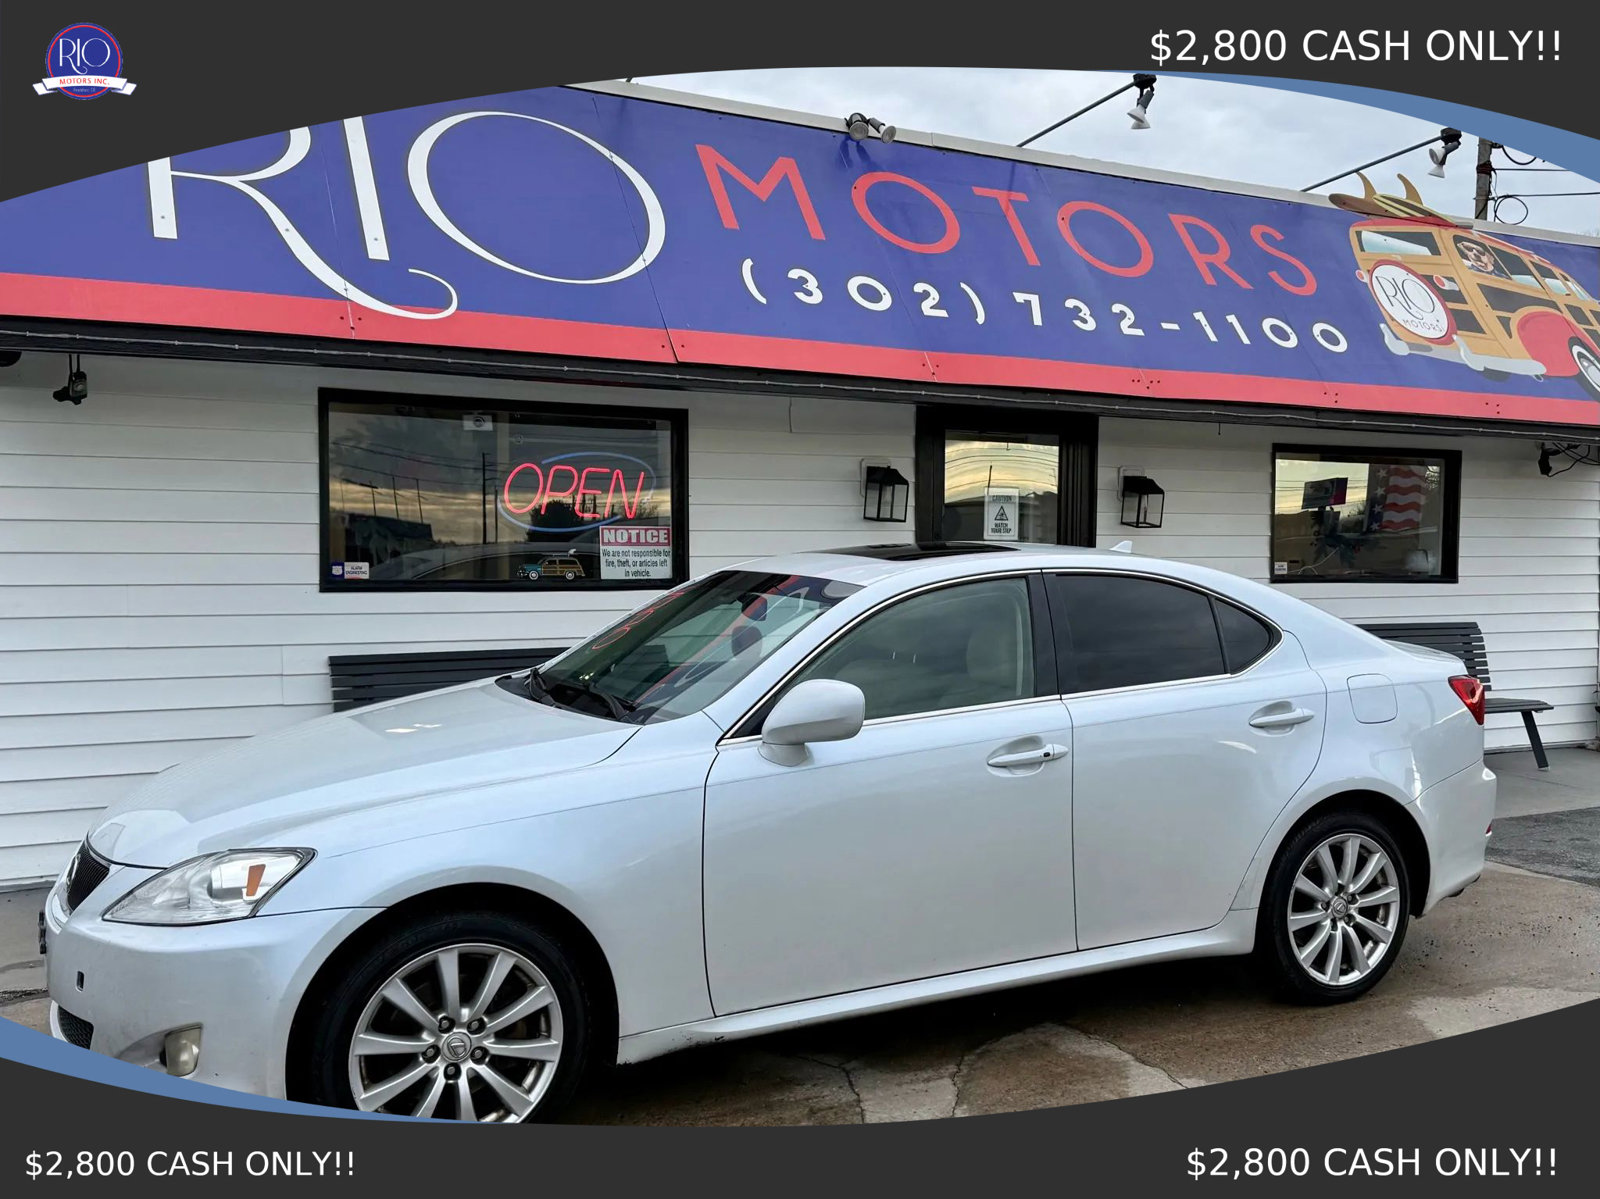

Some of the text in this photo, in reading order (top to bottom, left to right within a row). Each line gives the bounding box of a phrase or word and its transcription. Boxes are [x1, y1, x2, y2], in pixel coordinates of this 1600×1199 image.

[695, 143, 1318, 297] MOTORS
[1375, 275, 1435, 320] RIO
[741, 258, 1349, 354] (302) 732-1100
[1402, 318, 1443, 332] MOTORS
[503, 462, 645, 520] OPEN
[603, 528, 668, 543] NOTICE
[602, 549, 671, 558] We are not responsible for
[605, 558, 617, 568] fire,
[617, 559, 631, 568] theft,
[638, 558, 659, 567] articles
[659, 559, 668, 567] left
[624, 568, 651, 577] in vehicle.
